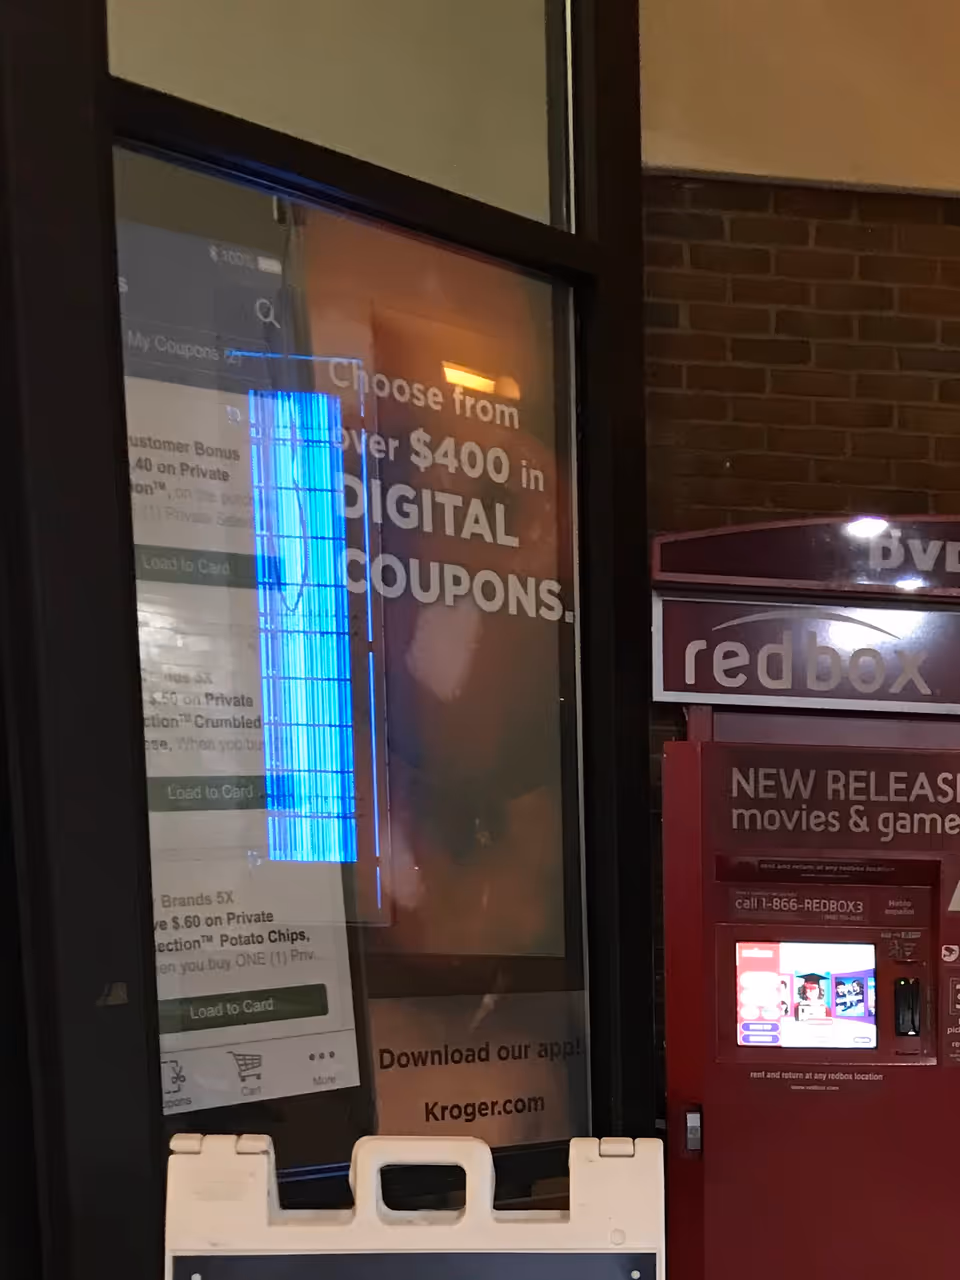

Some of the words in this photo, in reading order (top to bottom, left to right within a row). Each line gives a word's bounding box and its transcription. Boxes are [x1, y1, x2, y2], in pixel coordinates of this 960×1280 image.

[128, 331, 149, 352] My
[155, 336, 220, 361] Coupons
[329, 360, 443, 411] Choose
[453, 386, 520, 429] from
[194, 440, 241, 461] Bonus
[334, 427, 399, 460] over
[410, 428, 510, 482] $400
[522, 460, 544, 491] in
[157, 464, 176, 475] on
[180, 462, 230, 482] Private
[337, 472, 519, 547] DIGITAL
[143, 553, 177, 569] Load
[181, 558, 193, 570] to
[198, 559, 230, 575] Card
[344, 547, 574, 623] COUPONS.
[685, 630, 933, 696] redbox
[205, 692, 254, 707] Private
[194, 714, 261, 729] Crumbled
[247, 737, 263, 750] bu
[168, 785, 201, 799] Load
[206, 785, 217, 797] to
[222, 784, 254, 799] Card
[731, 767, 816, 800] NEW
[731, 804, 840, 833] movies
[848, 806, 876, 833] &
[161, 892, 212, 908] Brands
[217, 891, 234, 904] 5X
[735, 898, 758, 910] call
[762, 898, 864, 913] 1-866-REDBOX3
[172, 915, 201, 930] $.60
[205, 915, 223, 927] on
[226, 911, 274, 926] Private
[220, 931, 265, 947] Potato
[268, 929, 310, 945] Chips,
[181, 961, 206, 975] you
[209, 958, 231, 971] buy
[235, 953, 265, 967] ONE
[270, 951, 287, 967] (1)
[190, 1003, 223, 1019] Load
[226, 1001, 239, 1014] to
[243, 998, 273, 1013] Card
[379, 1042, 490, 1069] Download
[498, 1041, 530, 1061] our
[538, 1038, 581, 1062] app!
[313, 1074, 336, 1086] More
[814, 1073, 827, 1081] any
[828, 1072, 852, 1080] redbox
[854, 1073, 883, 1081] location
[241, 1085, 261, 1096] Cart
[425, 1096, 545, 1122] Kroger.com
